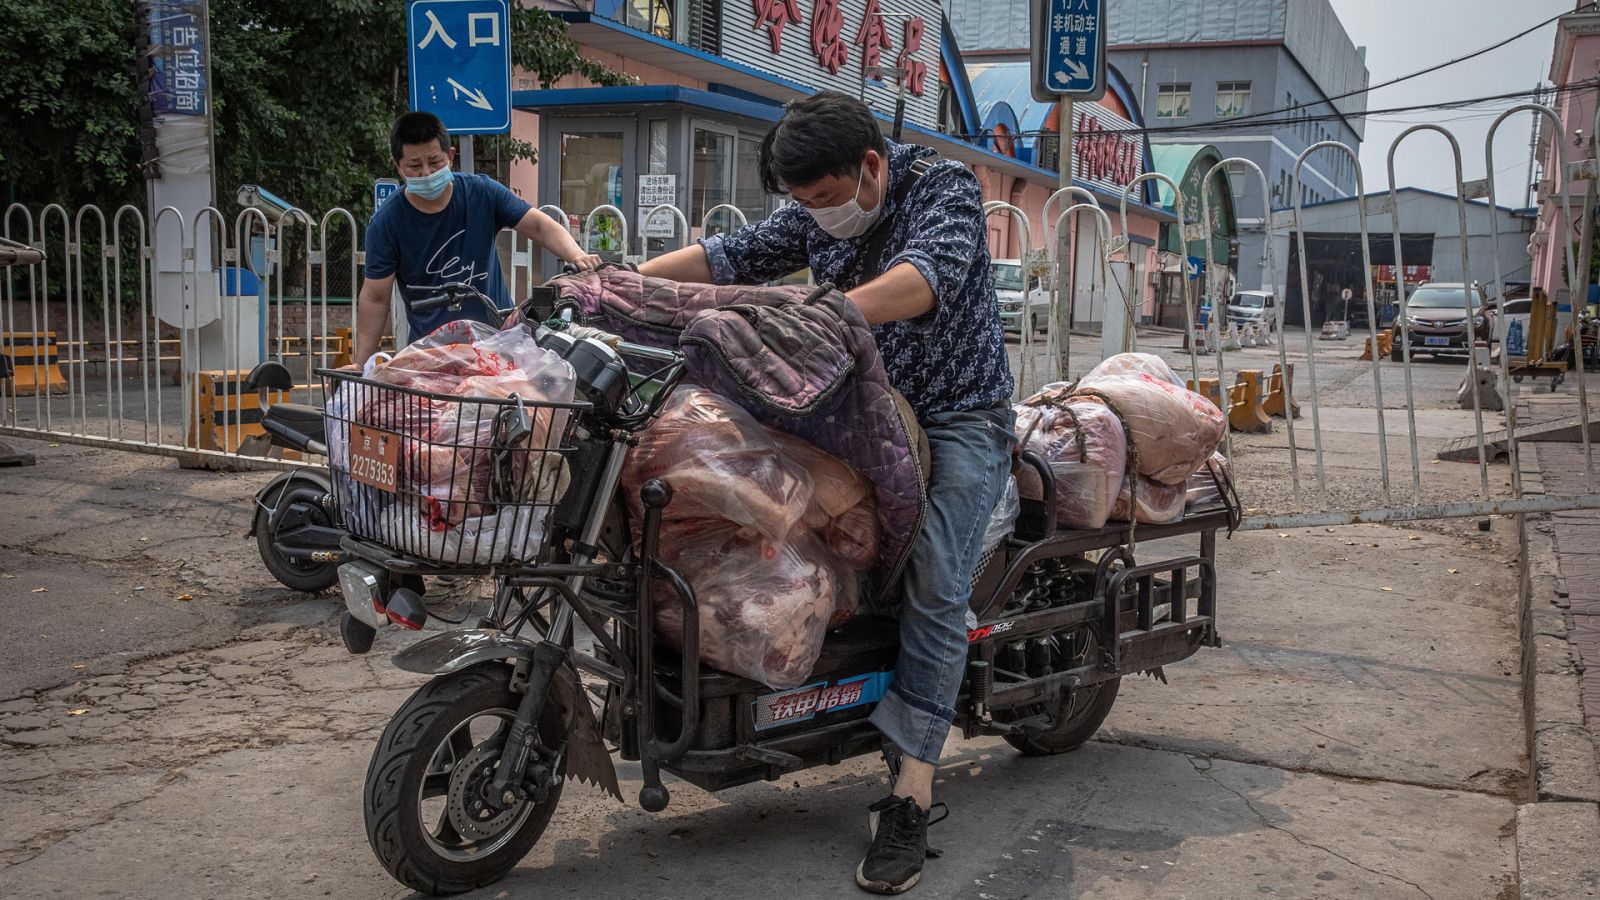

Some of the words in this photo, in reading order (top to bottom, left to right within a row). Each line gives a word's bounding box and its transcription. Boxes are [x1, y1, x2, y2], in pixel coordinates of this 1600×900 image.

[417, 9, 500, 50] 入口
[1053, 13, 1095, 33] 非机动车
[1059, 36, 1087, 55] 通道
[640, 186, 675, 195] 请出示身份证
[352, 453, 395, 486] 2275353
